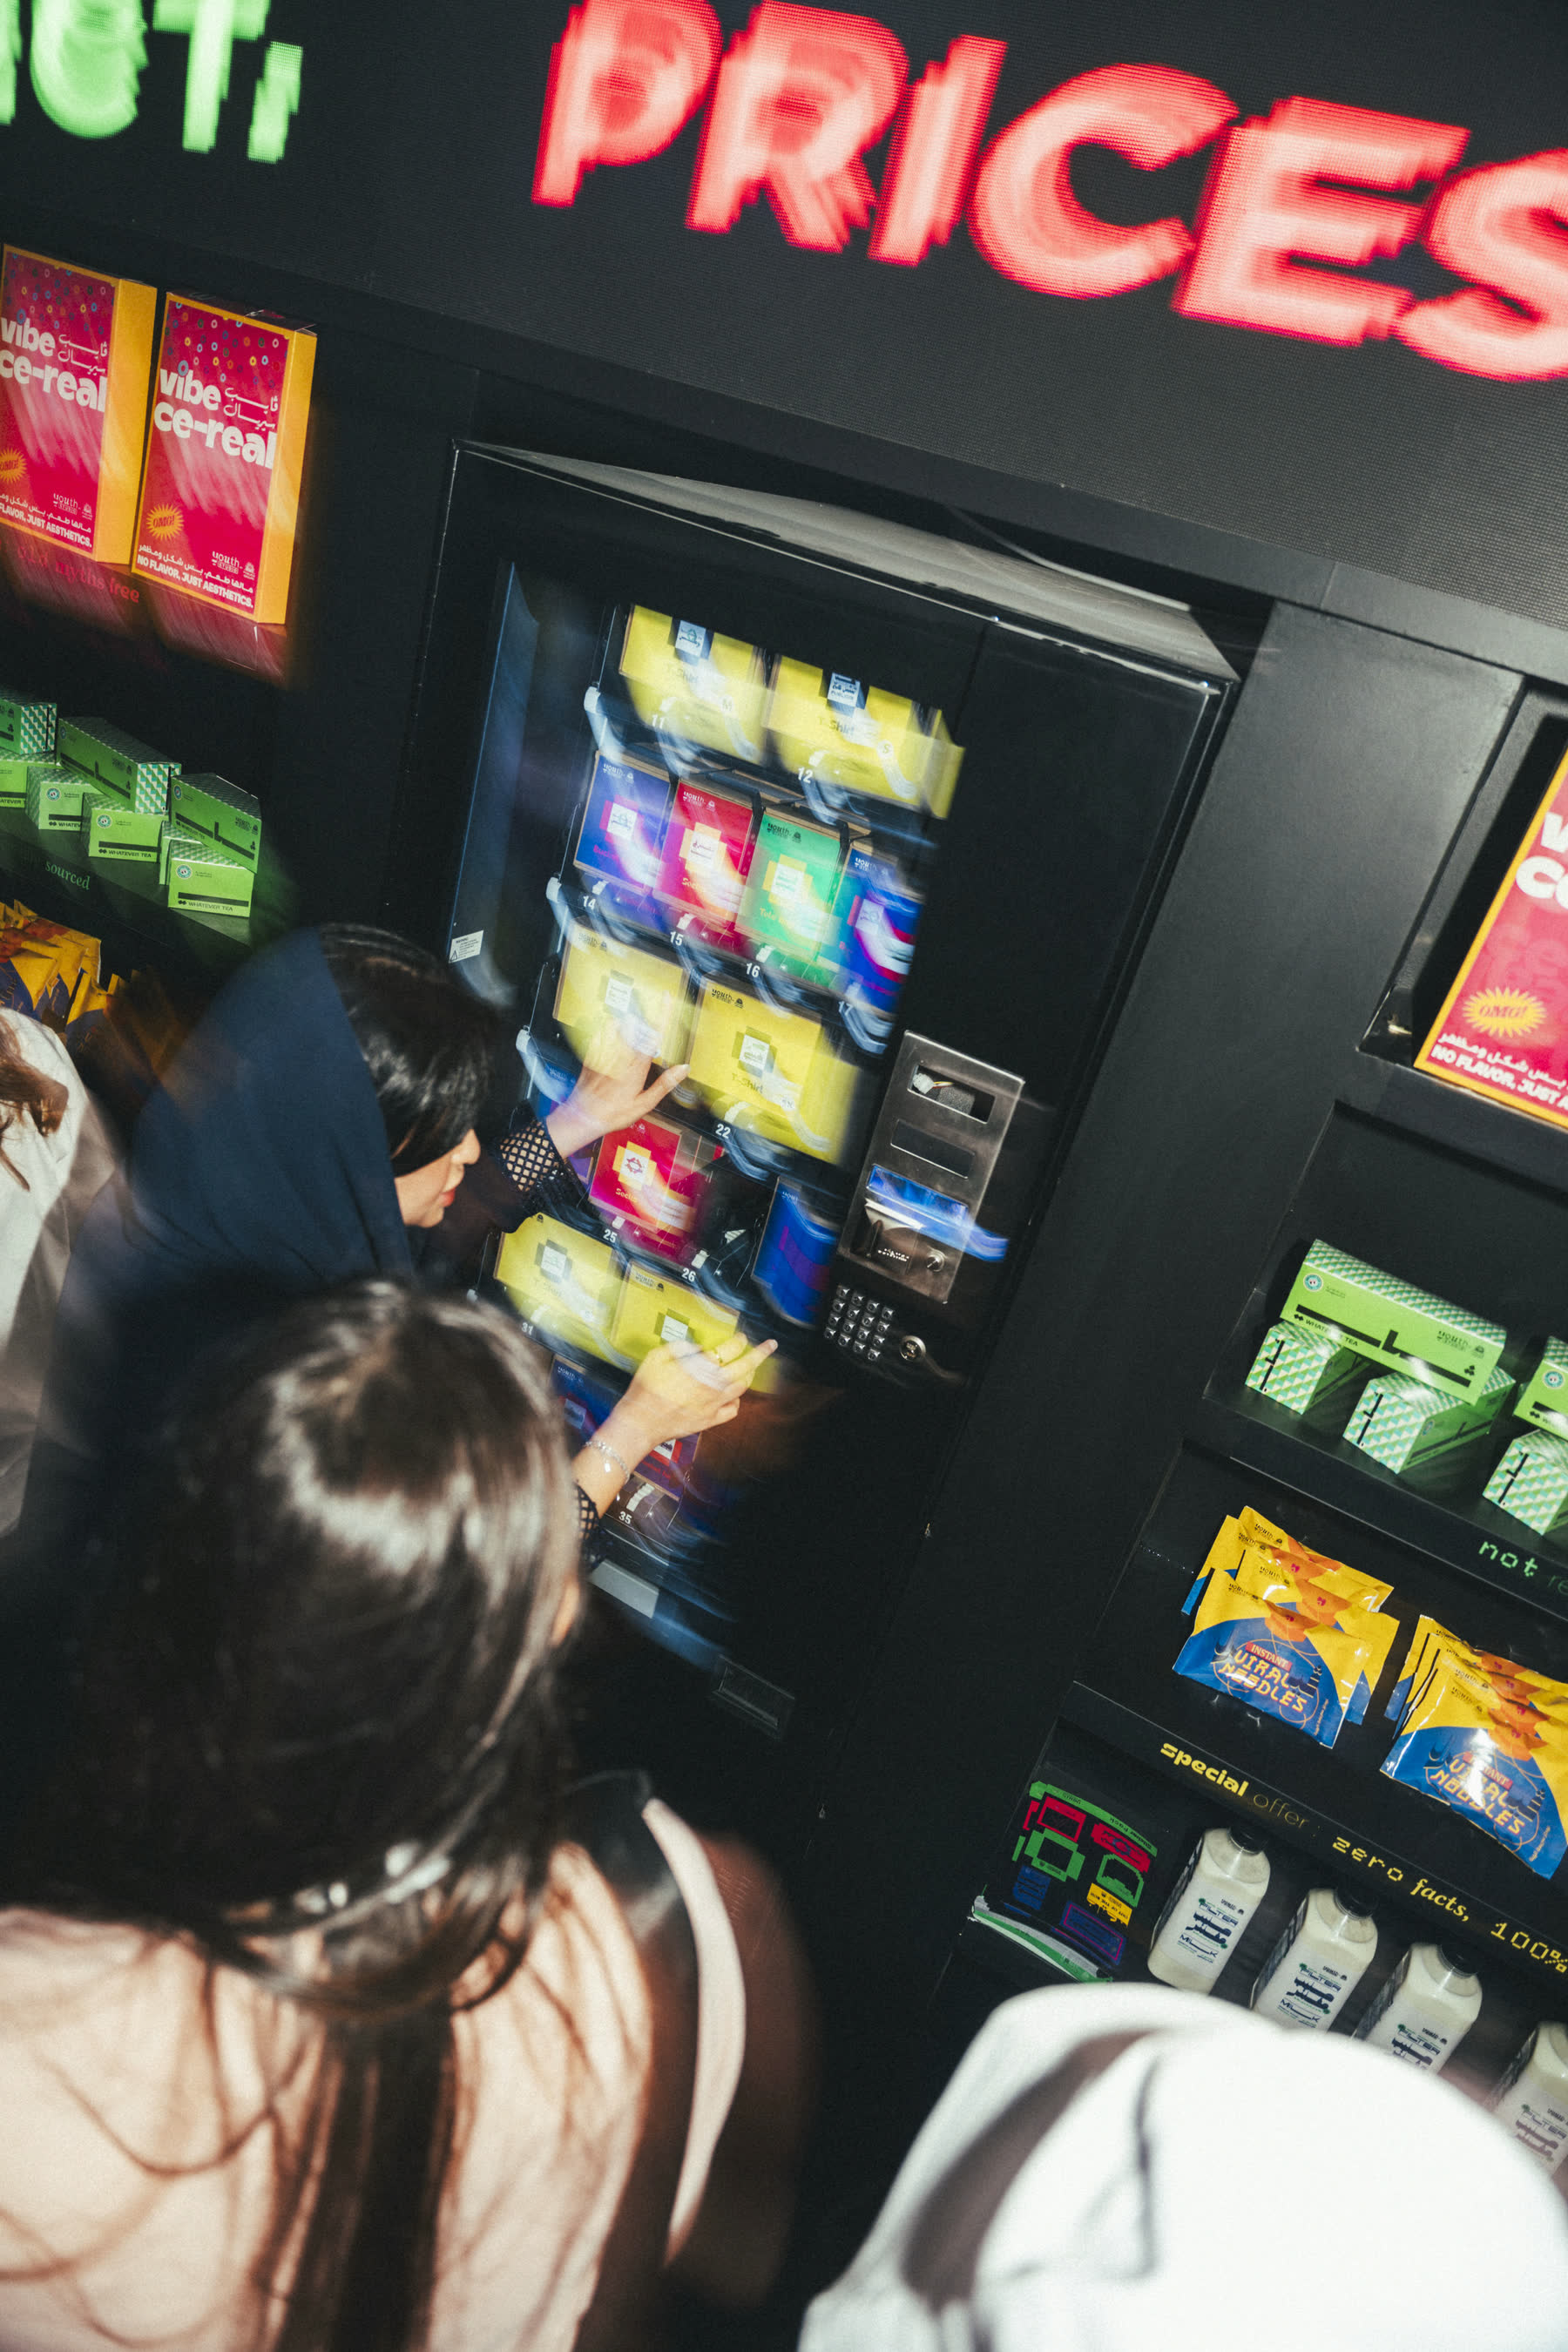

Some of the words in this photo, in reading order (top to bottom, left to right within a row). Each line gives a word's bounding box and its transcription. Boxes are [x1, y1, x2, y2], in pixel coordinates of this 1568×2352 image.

[532, 0, 1568, 383] PRICES
[1, 308, 56, 357] vibe
[0, 349, 108, 413] ce-real
[160, 360, 221, 410] vibe
[153, 402, 278, 470] ce-real
[26, 514, 46, 528] JUST
[46, 522, 92, 548] AESTHETICS.
[137, 554, 149, 567] NO
[181, 571, 203, 589] JUST
[203, 580, 254, 609] AESTHETICS.
[797, 766, 814, 784] 12
[45, 860, 91, 890] sourced
[583, 896, 596, 909] 14
[670, 930, 684, 946] 15
[746, 963, 760, 977] 16
[839, 1001, 854, 1016] 17
[1479, 1004, 1528, 1018] OMG!
[1430, 1044, 1457, 1064] NO
[1456, 1053, 1517, 1090] FLAVOR,
[1517, 1078, 1561, 1105] JUST
[715, 1123, 731, 1139] 22
[603, 1229, 617, 1244] 25
[682, 1267, 696, 1282] 26
[1345, 1336, 1359, 1347] TEA
[618, 1511, 632, 1524] 35
[1478, 1541, 1538, 1577] not
[1250, 1644, 1289, 1670] INSTANT
[1159, 1742, 1249, 1797] special
[1253, 1793, 1309, 1828] offer
[1333, 1836, 1403, 1882] zero
[1410, 1878, 1470, 1922] facts,
[1490, 1922, 1568, 1974] 100%
[1199, 1903, 1239, 1926] FILTER
[1300, 1967, 1342, 1991] FILTER
